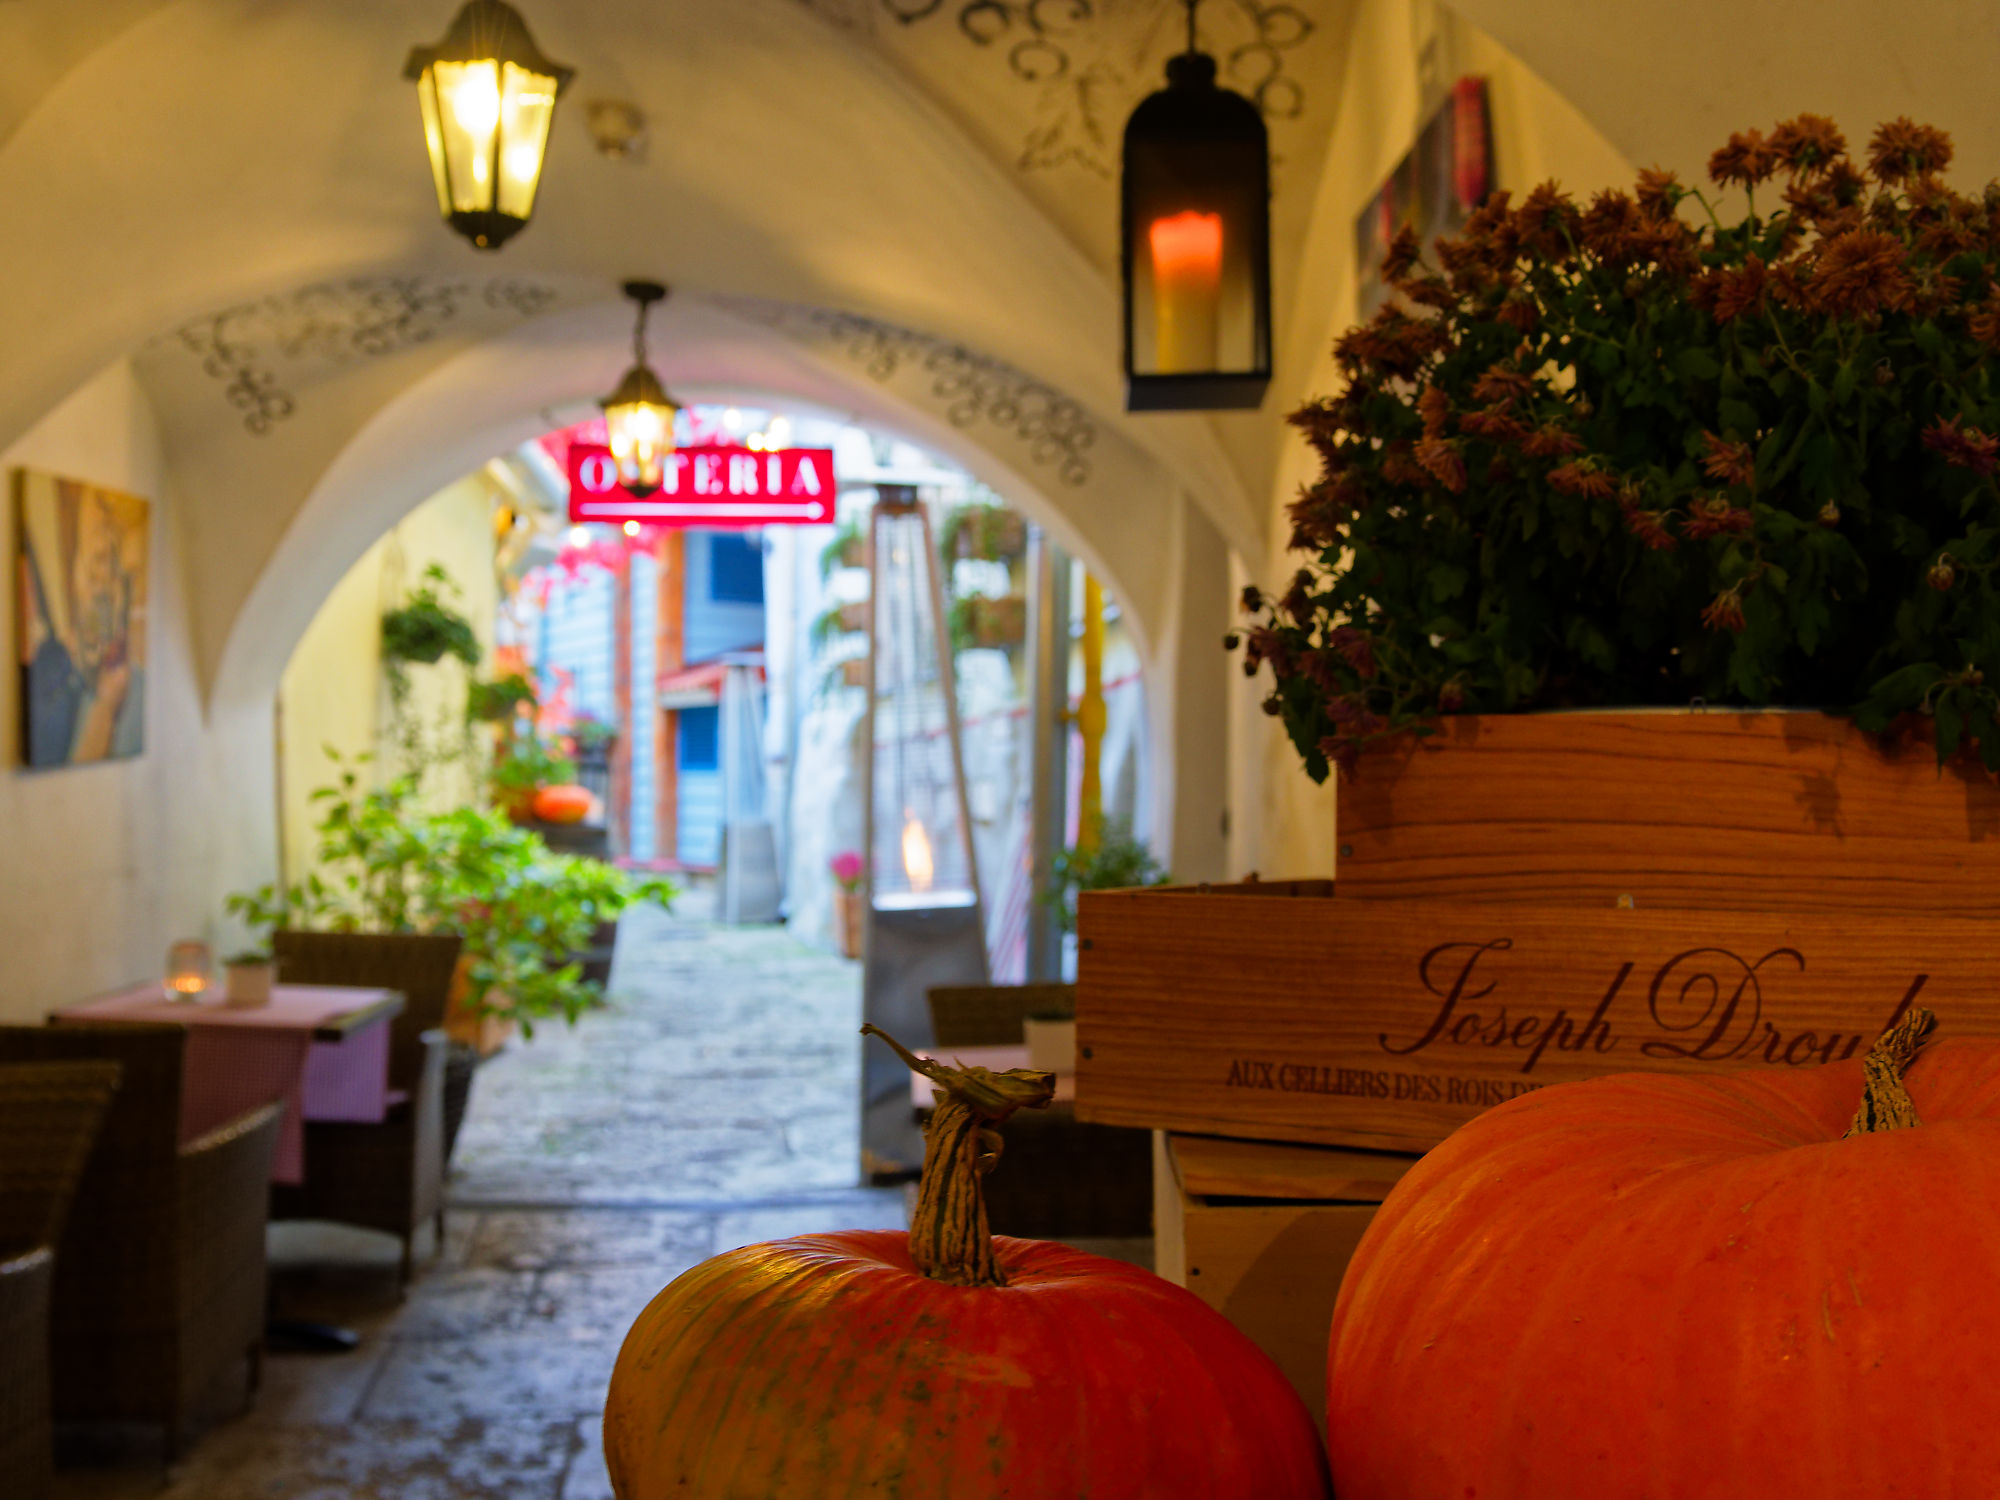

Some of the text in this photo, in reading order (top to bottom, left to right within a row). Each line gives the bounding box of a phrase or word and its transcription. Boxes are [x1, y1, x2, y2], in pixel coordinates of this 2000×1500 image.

[1378, 937, 1634, 1073] Joseph
[1226, 1059, 1275, 1090] AUX
[1278, 1063, 1390, 1098] CELLIERS
[1394, 1073, 1441, 1103] DES
[1447, 1077, 1505, 1107] ROIS
